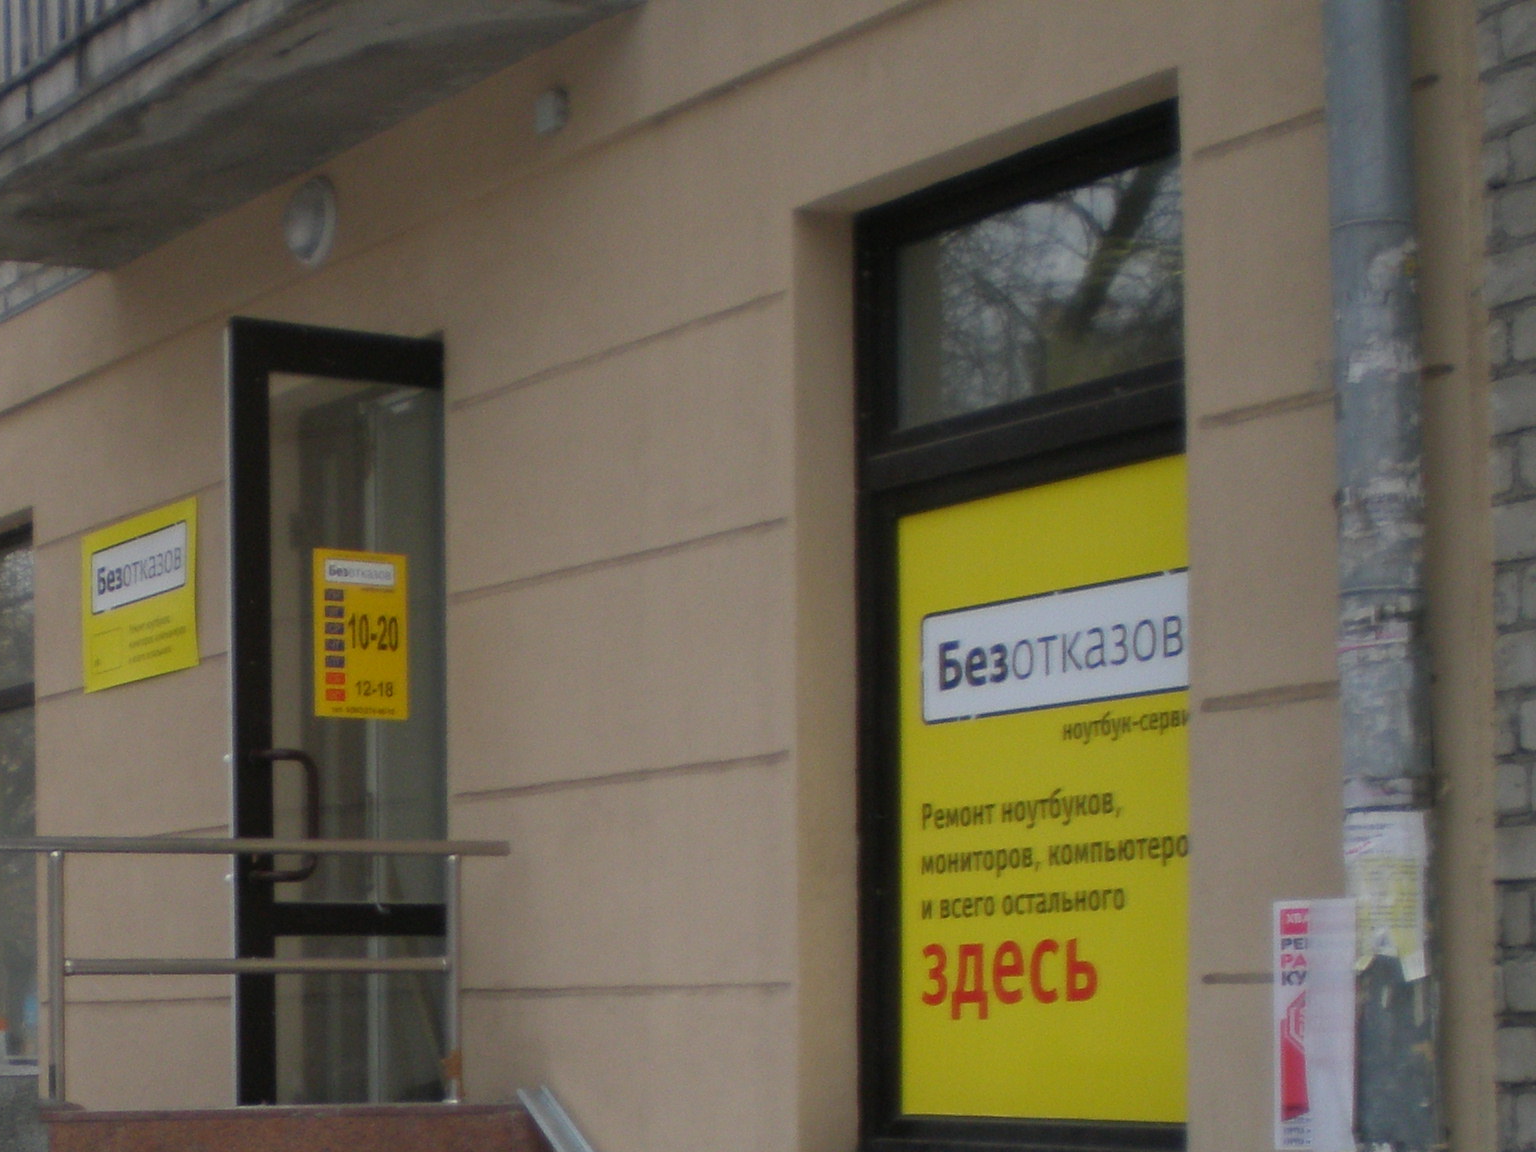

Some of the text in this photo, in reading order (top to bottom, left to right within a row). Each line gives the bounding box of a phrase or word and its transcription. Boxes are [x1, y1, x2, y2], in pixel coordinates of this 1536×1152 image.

[96, 546, 182, 597] Безотказов
[348, 613, 399, 652] 10-20
[937, 614, 1185, 692] Безотказов
[355, 680, 394, 698] 12-18
[921, 787, 1123, 831] Ремонт ноутбуков,
[920, 830, 1189, 878] мониторов, компьютеро
[921, 885, 1126, 921] и всего остального
[921, 936, 1099, 1020] здесь
